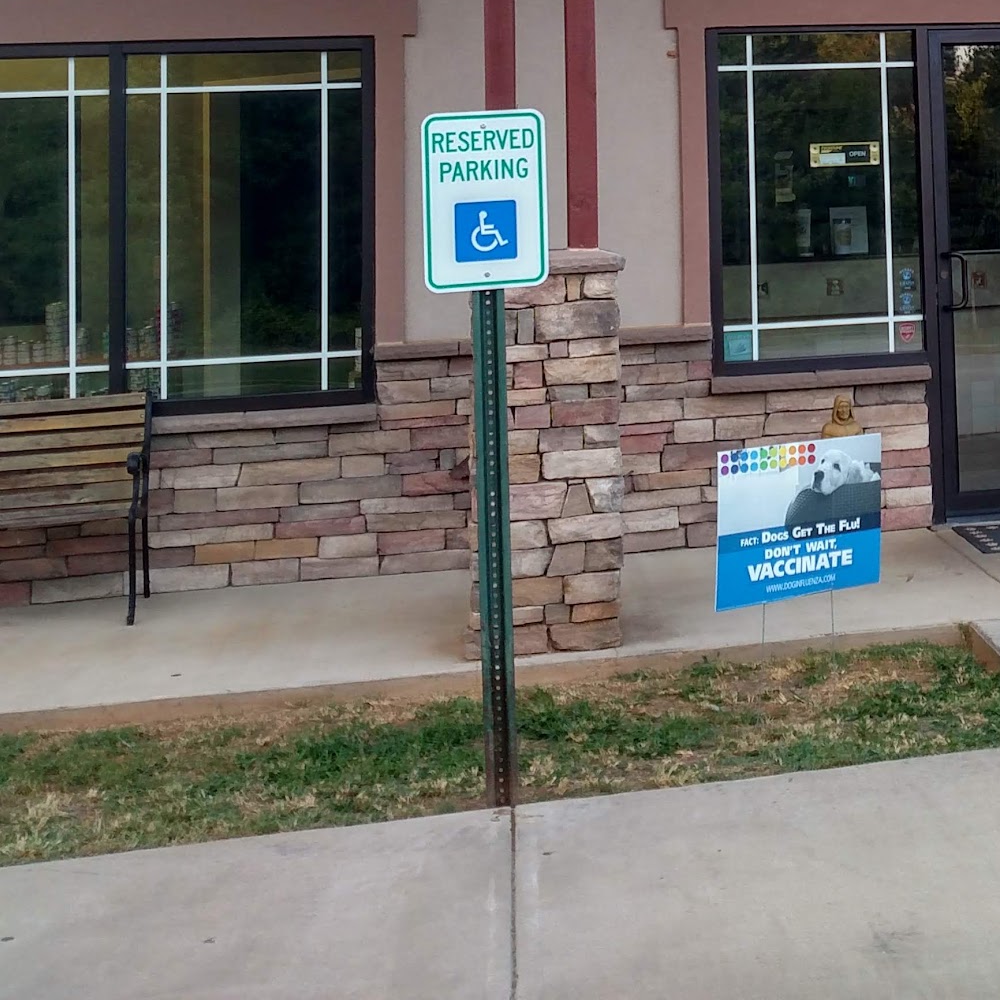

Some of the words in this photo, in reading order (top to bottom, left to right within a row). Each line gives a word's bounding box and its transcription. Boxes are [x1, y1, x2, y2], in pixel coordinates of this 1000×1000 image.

[432, 128, 534, 153] RESERVED
[440, 158, 528, 183] PARKING
[740, 537, 759, 547] FACT:
[764, 544, 801, 559] DON'T
[805, 538, 837, 553] WAIT,
[747, 548, 853, 582] VACCINATE
[765, 573, 836, 593] WWW.DOGINFLUENZA.COM
